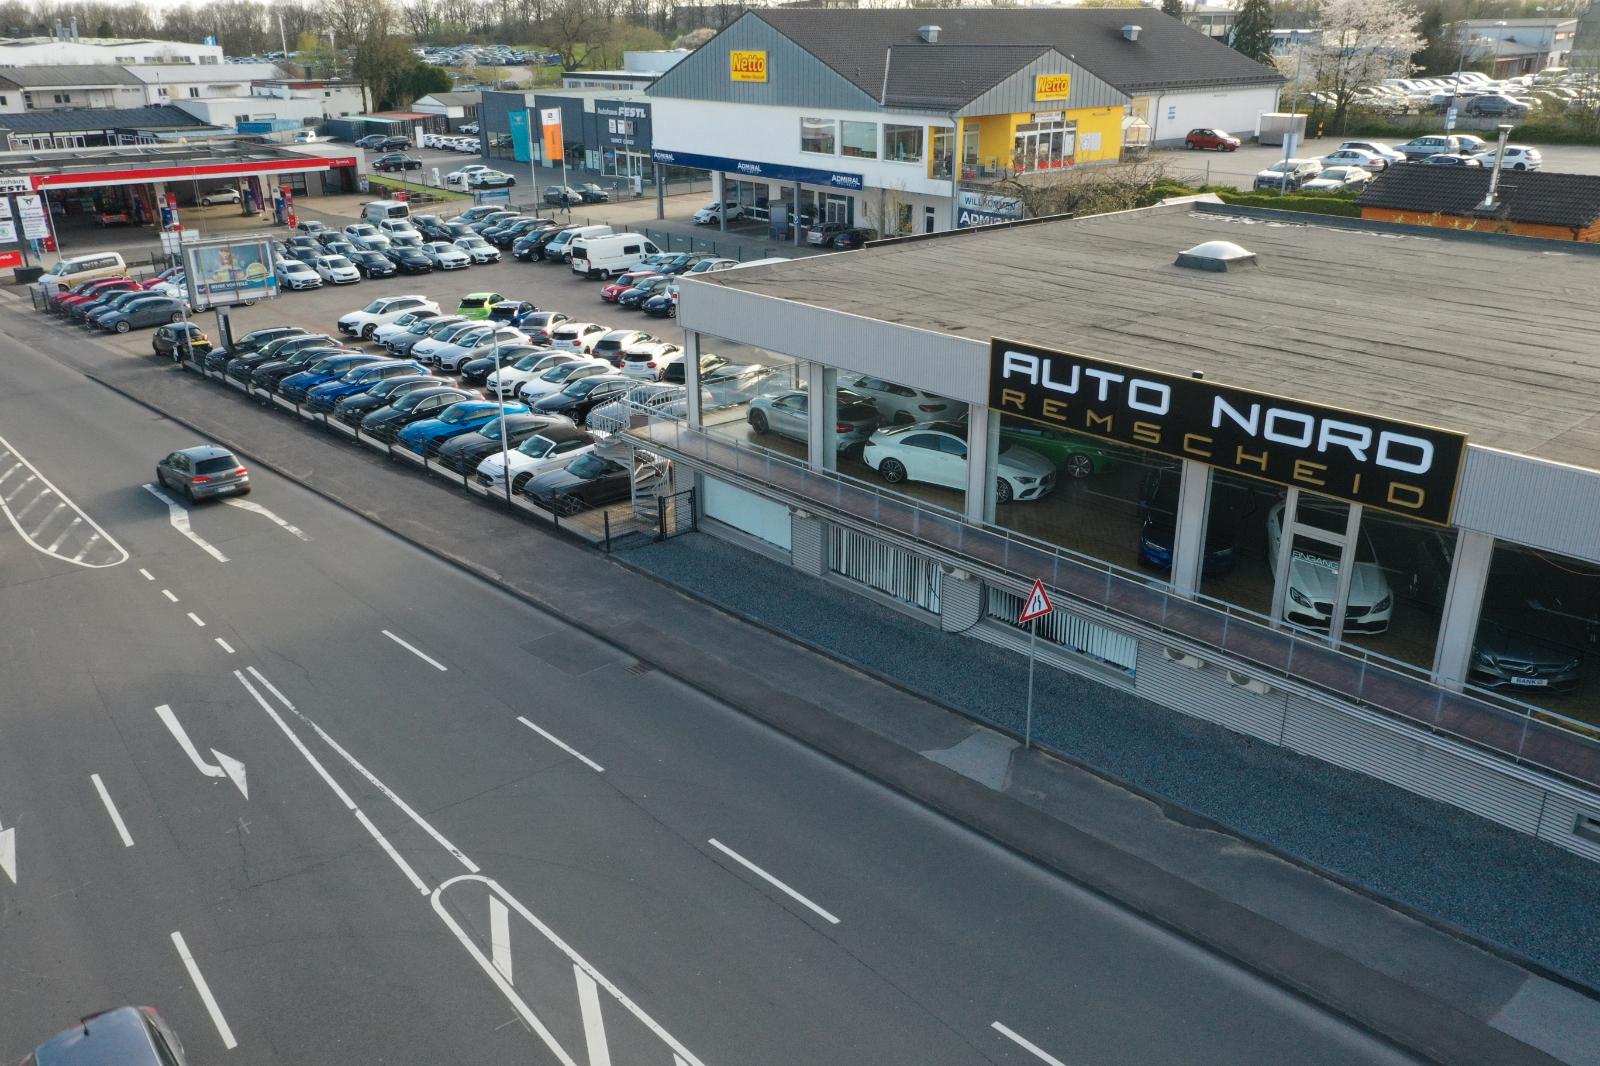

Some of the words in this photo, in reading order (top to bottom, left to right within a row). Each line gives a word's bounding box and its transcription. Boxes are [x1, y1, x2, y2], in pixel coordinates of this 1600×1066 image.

[732, 53, 764, 72] Netto
[1038, 77, 1068, 93] Netto
[618, 106, 646, 118] FESTL
[653, 151, 675, 161] ADMIRAL
[737, 162, 762, 172] ADMIRAL
[832, 174, 860, 185] ADMIRAL
[1003, 351, 1171, 415] AUTO
[1212, 395, 1434, 475] NORD
[1002, 388, 1425, 509] REMSCHEID
[1293, 550, 1339, 570] EINGANG
